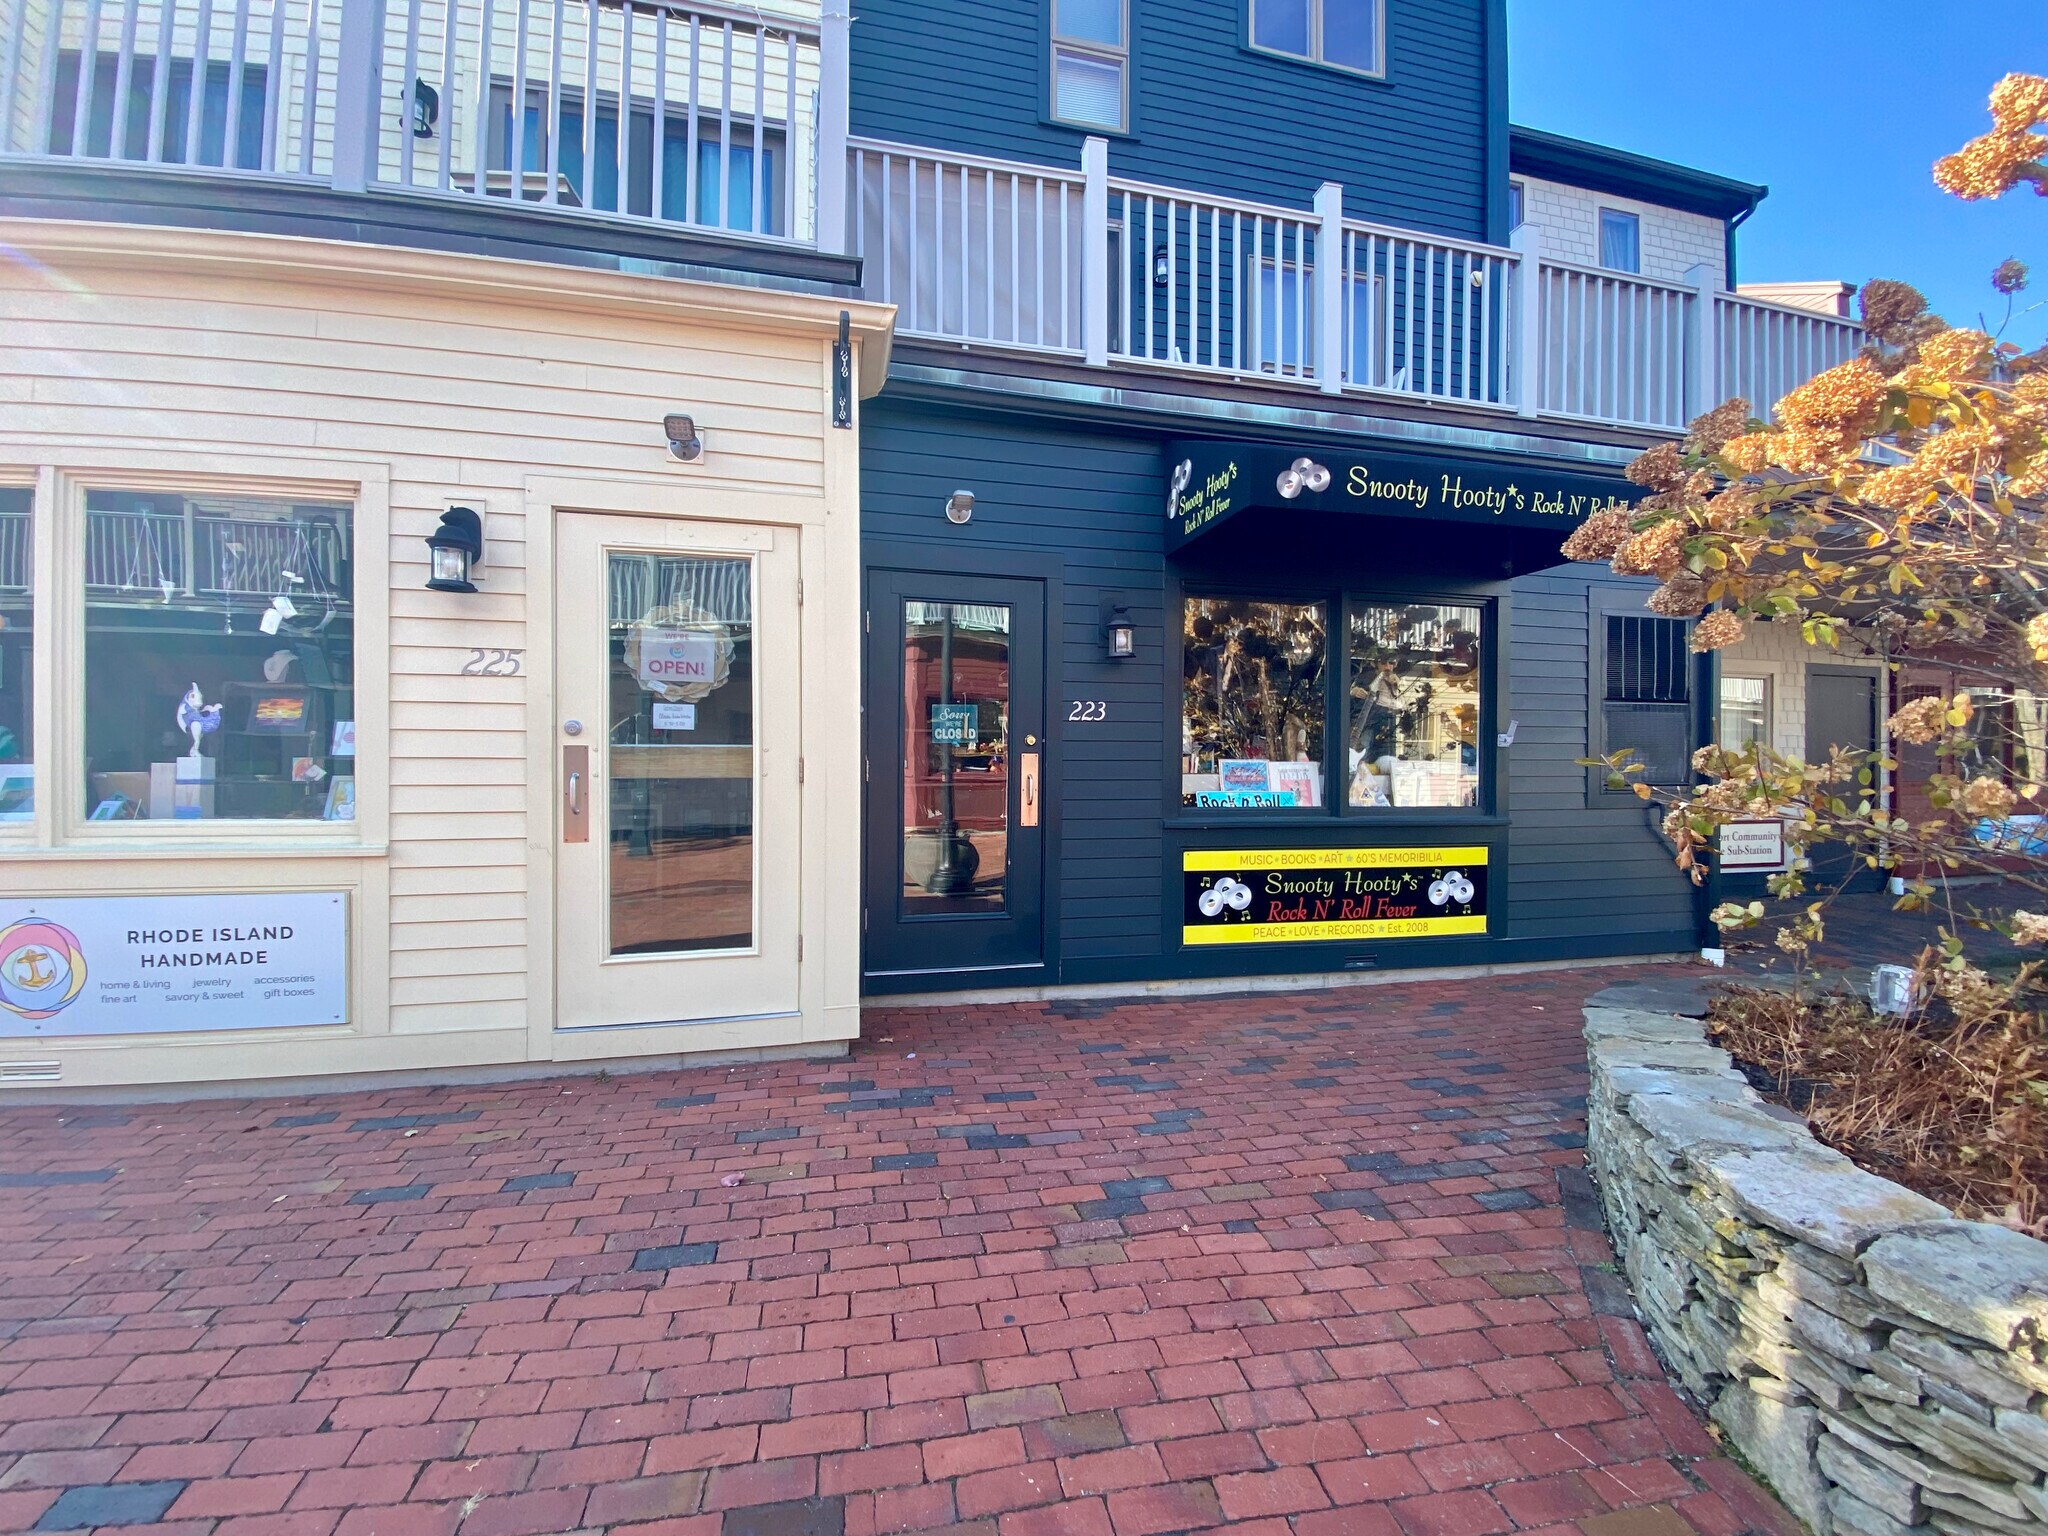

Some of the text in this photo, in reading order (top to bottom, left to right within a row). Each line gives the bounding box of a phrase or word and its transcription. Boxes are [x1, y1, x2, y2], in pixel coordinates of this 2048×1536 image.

[1346, 465, 1429, 508] Snooty
[1531, 490, 1564, 515] Rock
[1567, 495, 1586, 516] N'
[1179, 490, 1204, 516] Snooty
[1185, 512, 1197, 535] Rock
[1205, 499, 1215, 522] Roll
[1215, 497, 1231, 515] Fever
[461, 649, 523, 676] 225
[648, 660, 705, 676] OPEN!
[940, 708, 970, 721] Sorry
[1069, 700, 1106, 721] 223
[934, 728, 976, 739] CLOSD
[1254, 794, 1280, 808] Roll
[1732, 831, 1777, 842] Community
[1239, 852, 1443, 865] MUSIC BOOKS ART 60'S MEMORIBILIA
[1727, 845, 1772, 856] Sub-Station
[1264, 872, 1334, 897] Snooty
[1266, 895, 1417, 922] Rock N' Roll Fever
[127, 926, 295, 944] RHODE ISLAND
[1253, 922, 1429, 938] PEACE LOVE RECORDS Est. 2008
[141, 950, 269, 968] HANDMADE
[100, 975, 315, 990] home & living jewelry accessories
[101, 987, 315, 1004] fine art savory & sweet gift boxes
